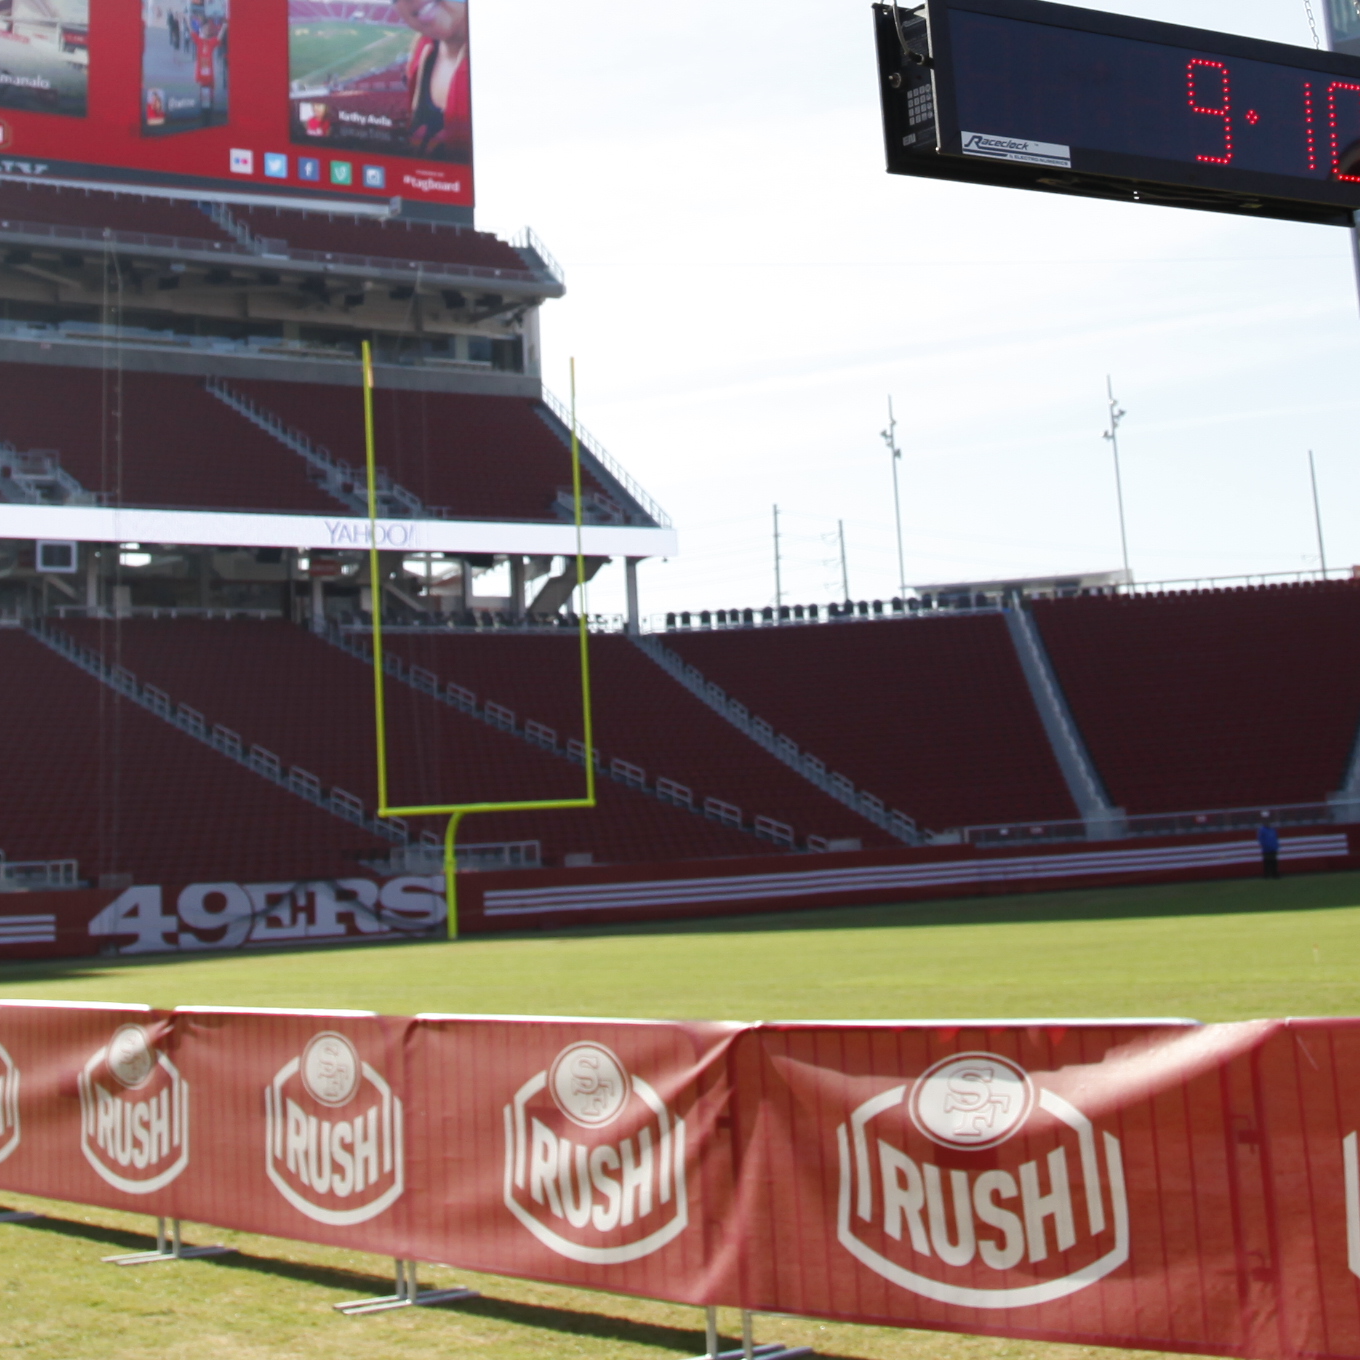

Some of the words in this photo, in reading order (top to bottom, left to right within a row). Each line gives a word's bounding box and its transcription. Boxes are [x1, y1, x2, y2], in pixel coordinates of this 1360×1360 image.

[964, 134, 1029, 151] Raceclock
[324, 519, 416, 547] YAHOO!
[88, 874, 452, 955] 49ERS
[96, 1082, 170, 1169] RUSH
[286, 1096, 378, 1198] RUSH
[530, 1115, 653, 1233] RUSH
[877, 1138, 1076, 1271] RUSH
